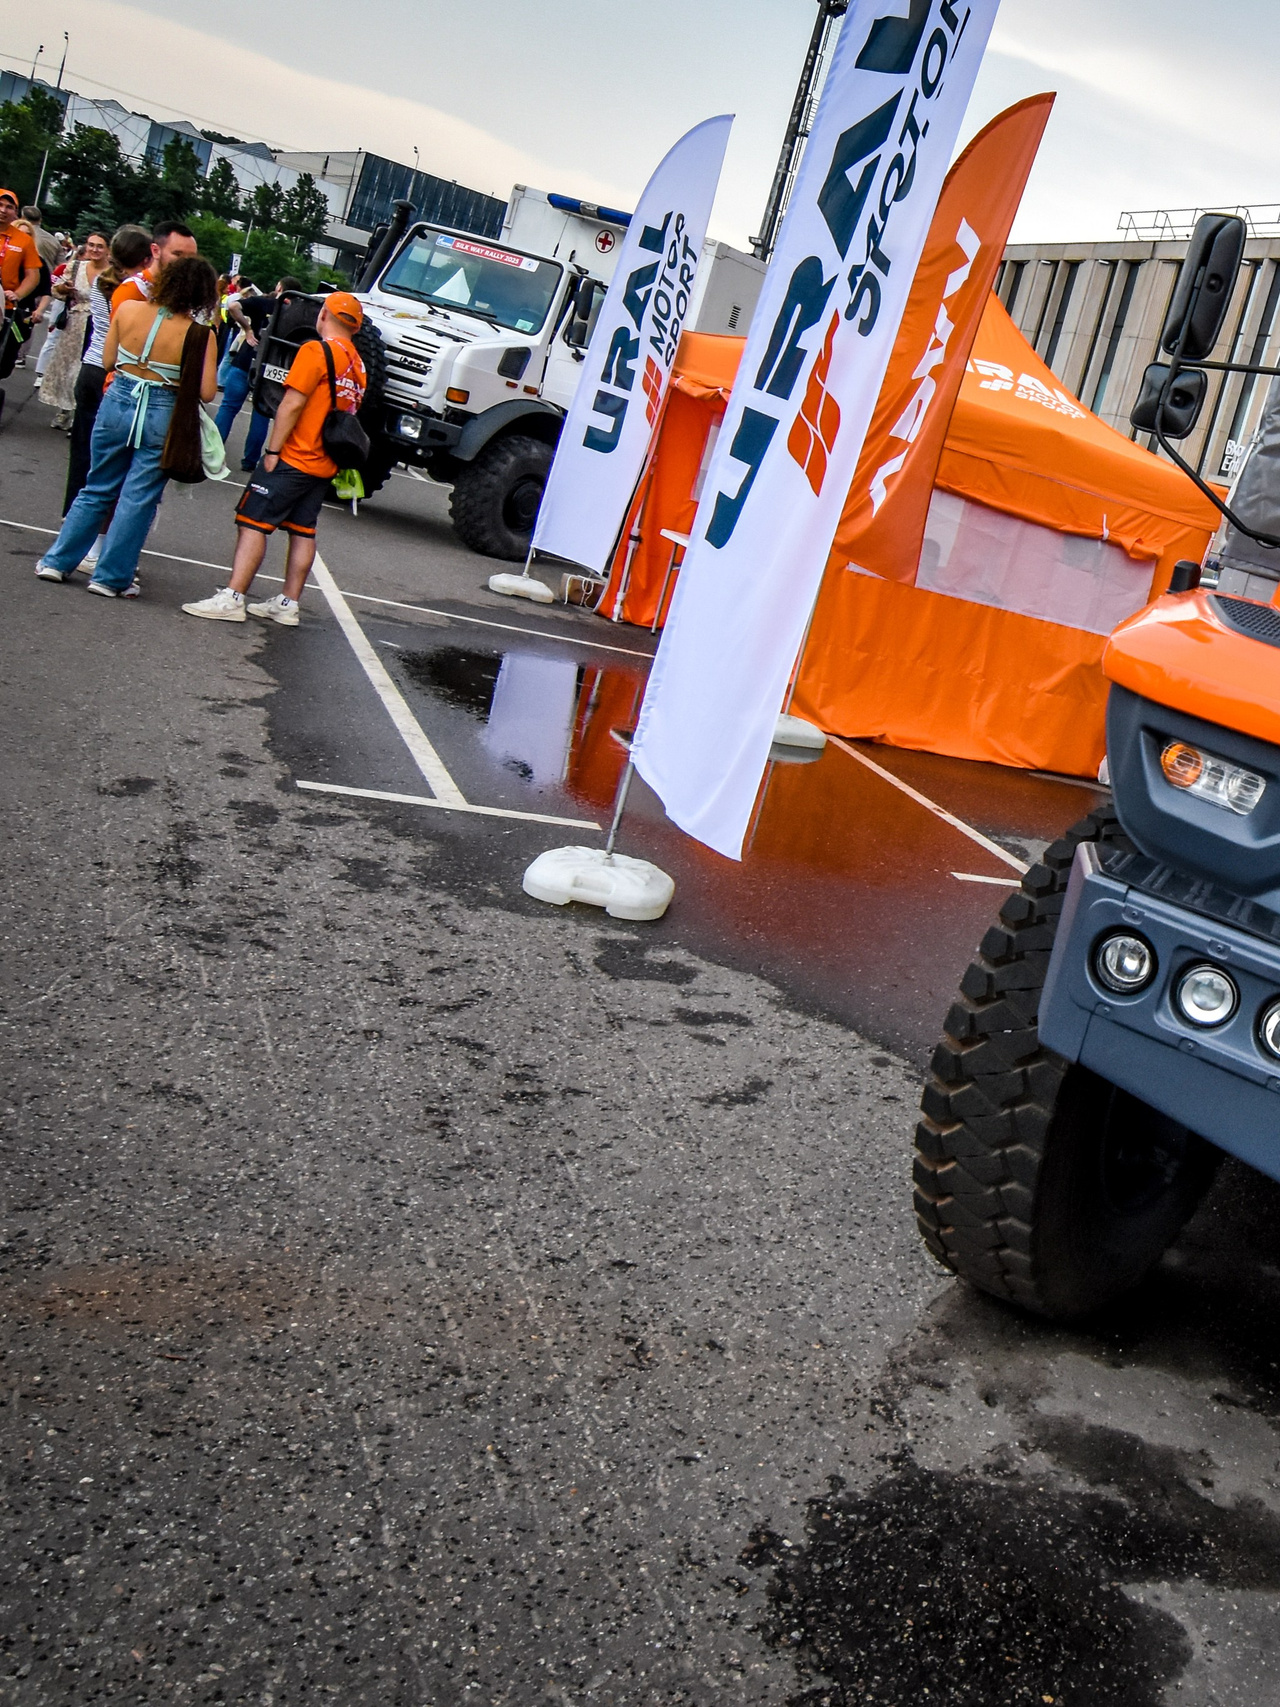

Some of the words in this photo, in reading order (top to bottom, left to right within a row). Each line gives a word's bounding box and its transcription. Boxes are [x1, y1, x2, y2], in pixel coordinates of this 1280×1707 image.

[455, 242, 470, 251] SILK
[470, 246, 486, 255] WAY
[484, 249, 505, 261] RALLY
[504, 255, 520, 264] 2025
[649, 213, 685, 356] MOTOR
[582, 211, 674, 454] URAL
[664, 234, 698, 369] SPORT
[1014, 391, 1081, 419] SPORT
[1017, 385, 1087, 419] MOTOR
